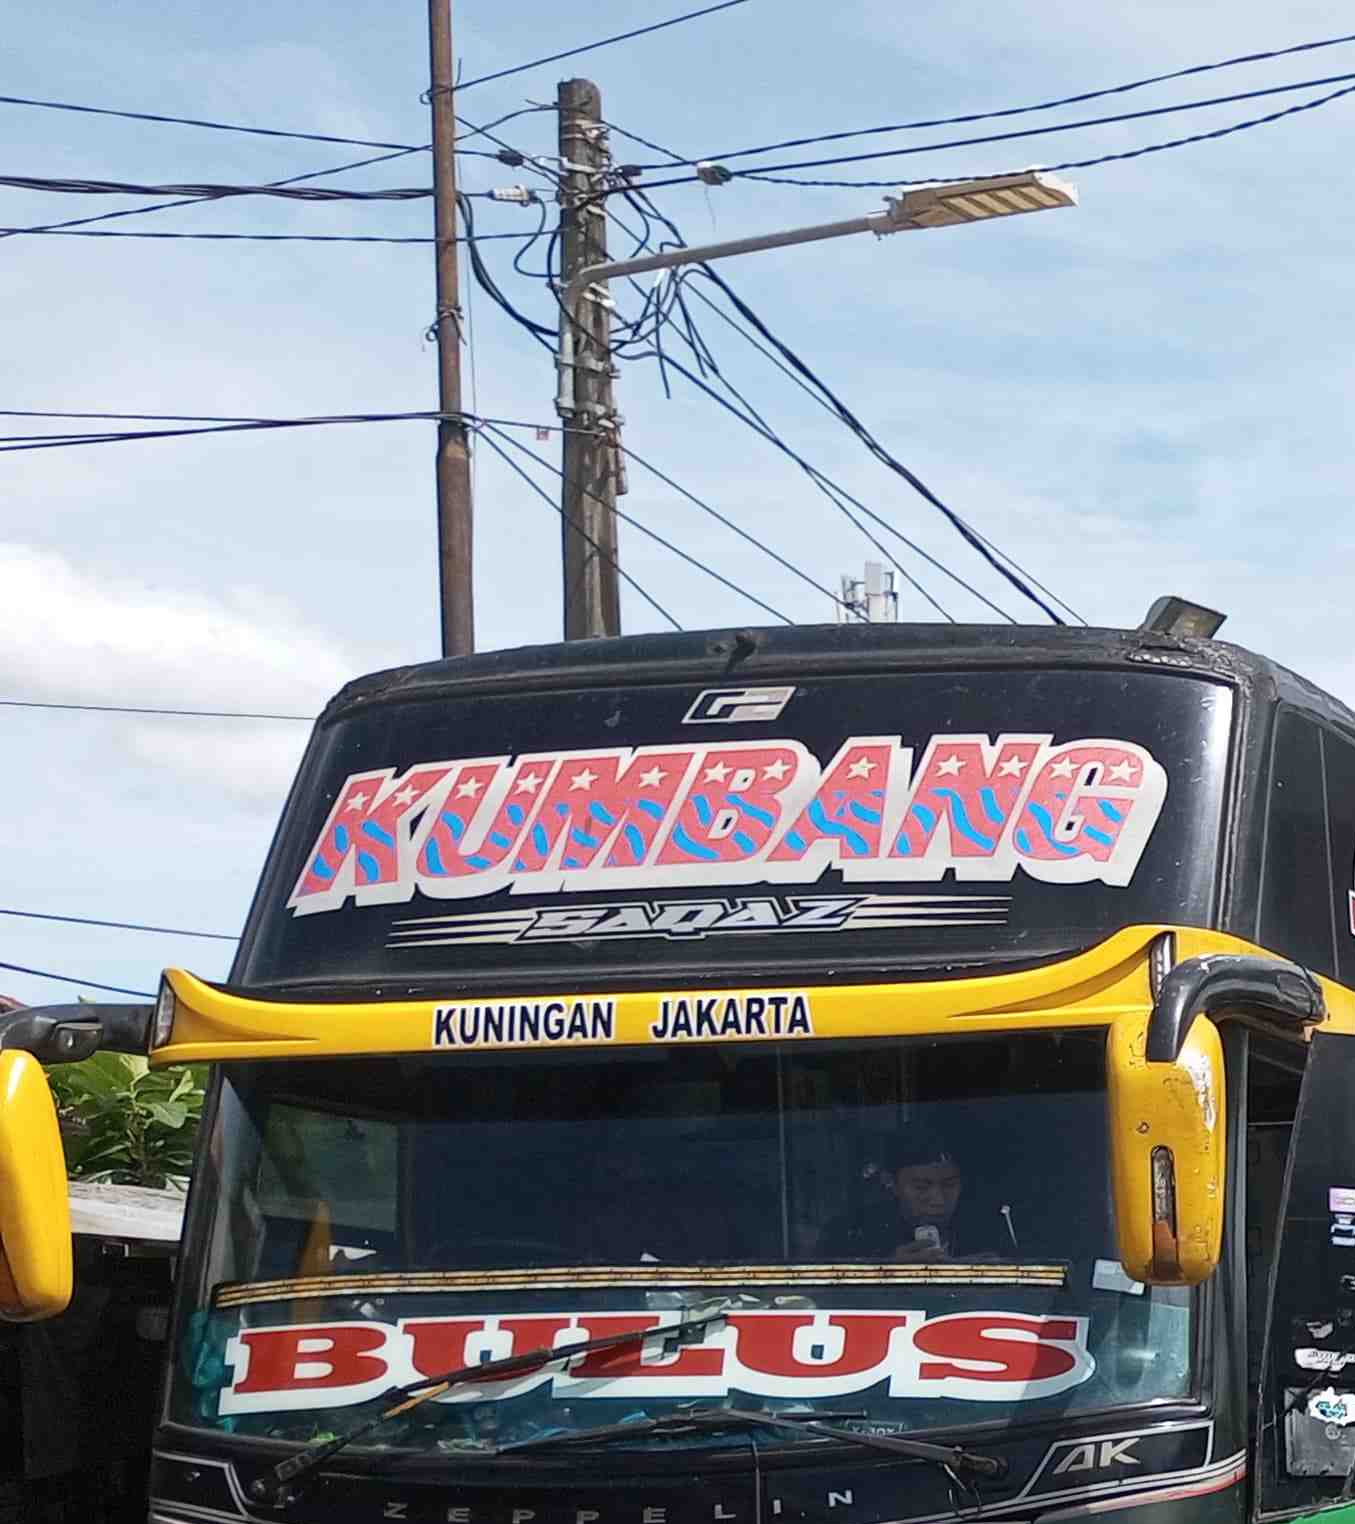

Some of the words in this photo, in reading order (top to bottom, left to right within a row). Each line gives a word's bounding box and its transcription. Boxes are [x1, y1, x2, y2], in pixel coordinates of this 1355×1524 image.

[286, 735, 1168, 916] KUMBANG
[434, 1002, 613, 1046] KUNINGAN
[651, 996, 810, 1039] JAKARTA
[218, 1310, 1097, 1416] BULUS
[1053, 1437, 1141, 1475] AK
[384, 1490, 854, 1524] ZEPPELIN
